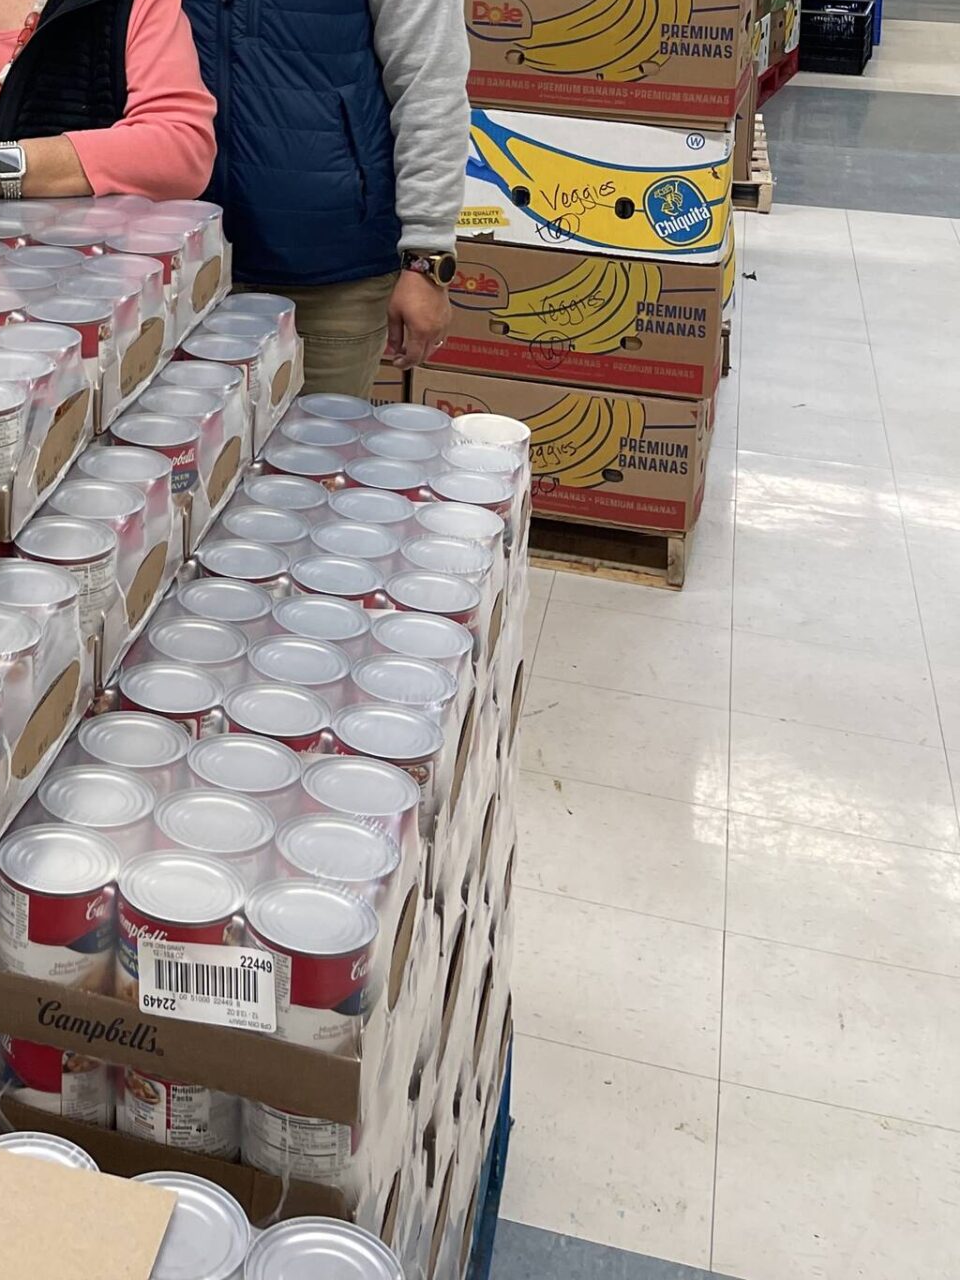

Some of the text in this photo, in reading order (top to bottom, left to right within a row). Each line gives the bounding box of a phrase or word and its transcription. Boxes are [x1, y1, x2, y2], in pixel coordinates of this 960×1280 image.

[472, 1, 523, 23] Dole
[661, 23, 734, 41] PREMIUM
[660, 40, 733, 59] BANANAS
[486, 78, 531, 90] BANANAS
[537, 81, 582, 93] PREMIUM
[540, 180, 616, 216] Veggies
[654, 202, 711, 239] Chiquita
[636, 301, 707, 321] PREMIUM
[635, 319, 707, 339] BANANAS
[620, 436, 689, 459] PREMIUM
[619, 453, 688, 475] BANANAS
[594, 496, 634, 511] PREMIUM
[240, 955, 273, 974] 22449
[143, 994, 176, 1011] 22449
[38, 997, 159, 1053] Campbell's
[171, 1094, 193, 1102] Facts
